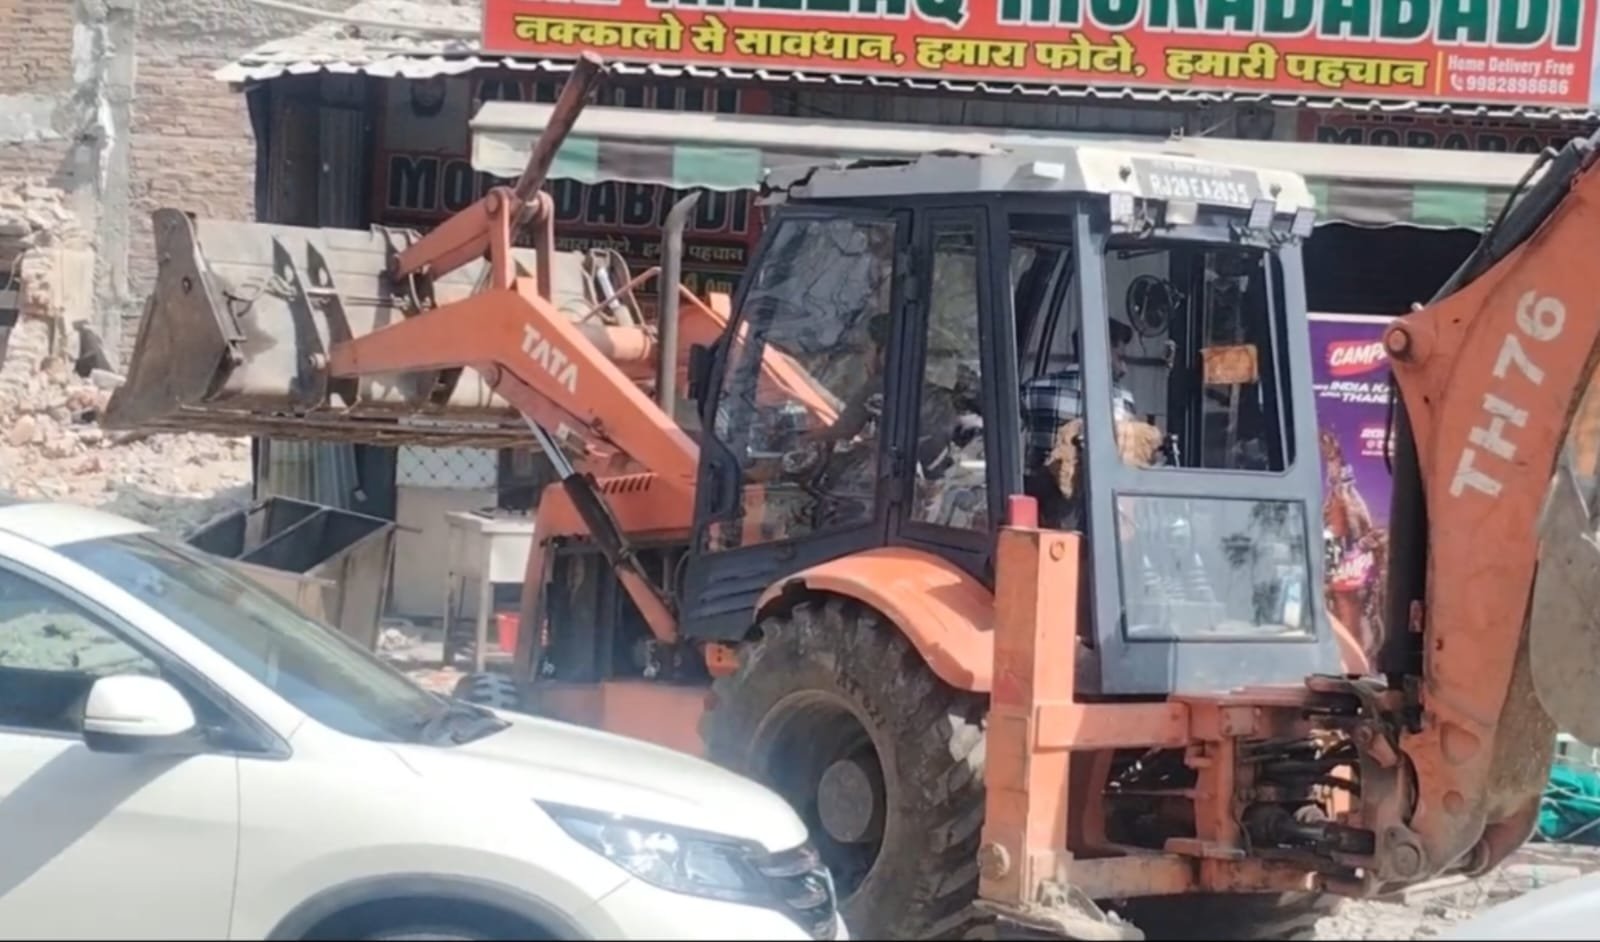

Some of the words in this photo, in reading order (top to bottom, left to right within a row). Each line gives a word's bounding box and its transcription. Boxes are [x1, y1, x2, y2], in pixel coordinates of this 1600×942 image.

[514, 12, 684, 50] नक्कालो
[691, 14, 727, 53] से
[733, 28, 906, 66] सावधान,
[915, 36, 1028, 69] हमारा
[1034, 32, 1146, 77] फोटो,
[1165, 42, 1279, 81] हमारी
[1284, 53, 1429, 88] पहचान
[1448, 54, 1486, 72] Home
[1488, 56, 1543, 78] Delivery
[1545, 58, 1575, 76] Free
[521, 322, 579, 394] TATA
[1450, 393, 1530, 497] TH
[1491, 289, 1567, 386] 76
